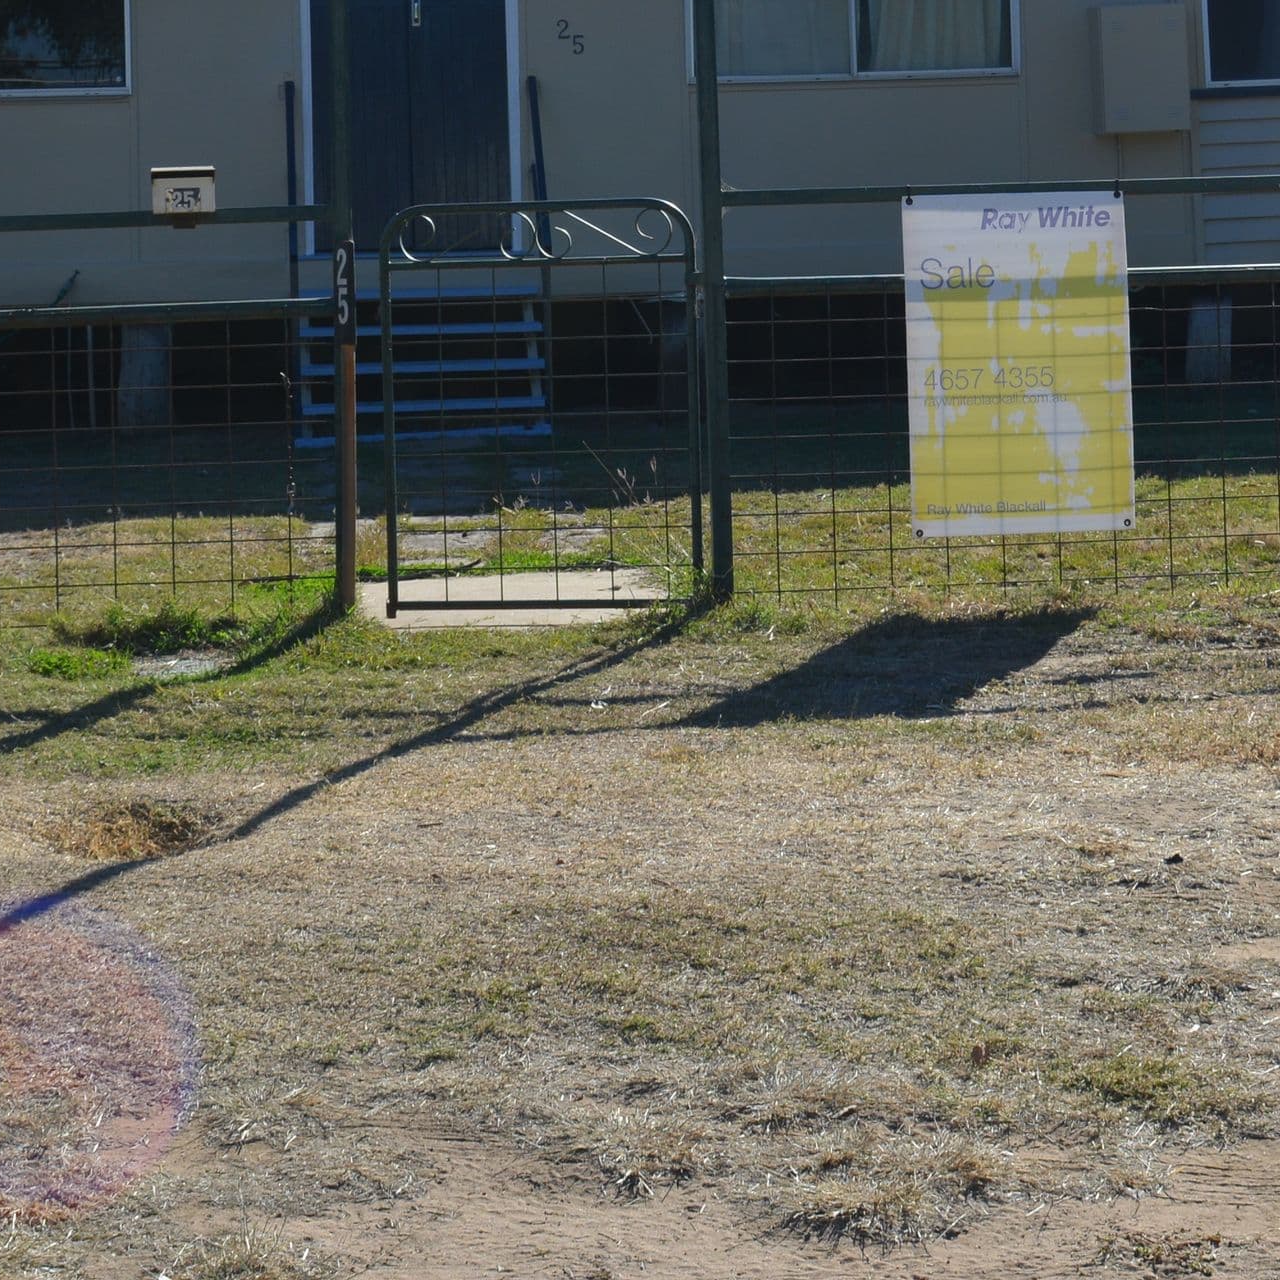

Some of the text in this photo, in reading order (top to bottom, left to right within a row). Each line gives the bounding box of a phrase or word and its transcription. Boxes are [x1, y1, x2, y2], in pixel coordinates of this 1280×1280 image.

[556, 19, 585, 55] 25
[173, 191, 195, 210] 25
[981, 206, 1111, 233] Ray White
[920, 257, 995, 289] Sale
[923, 366, 1054, 390] 4657 4355
[927, 500, 1047, 517] Ray White Blackall
